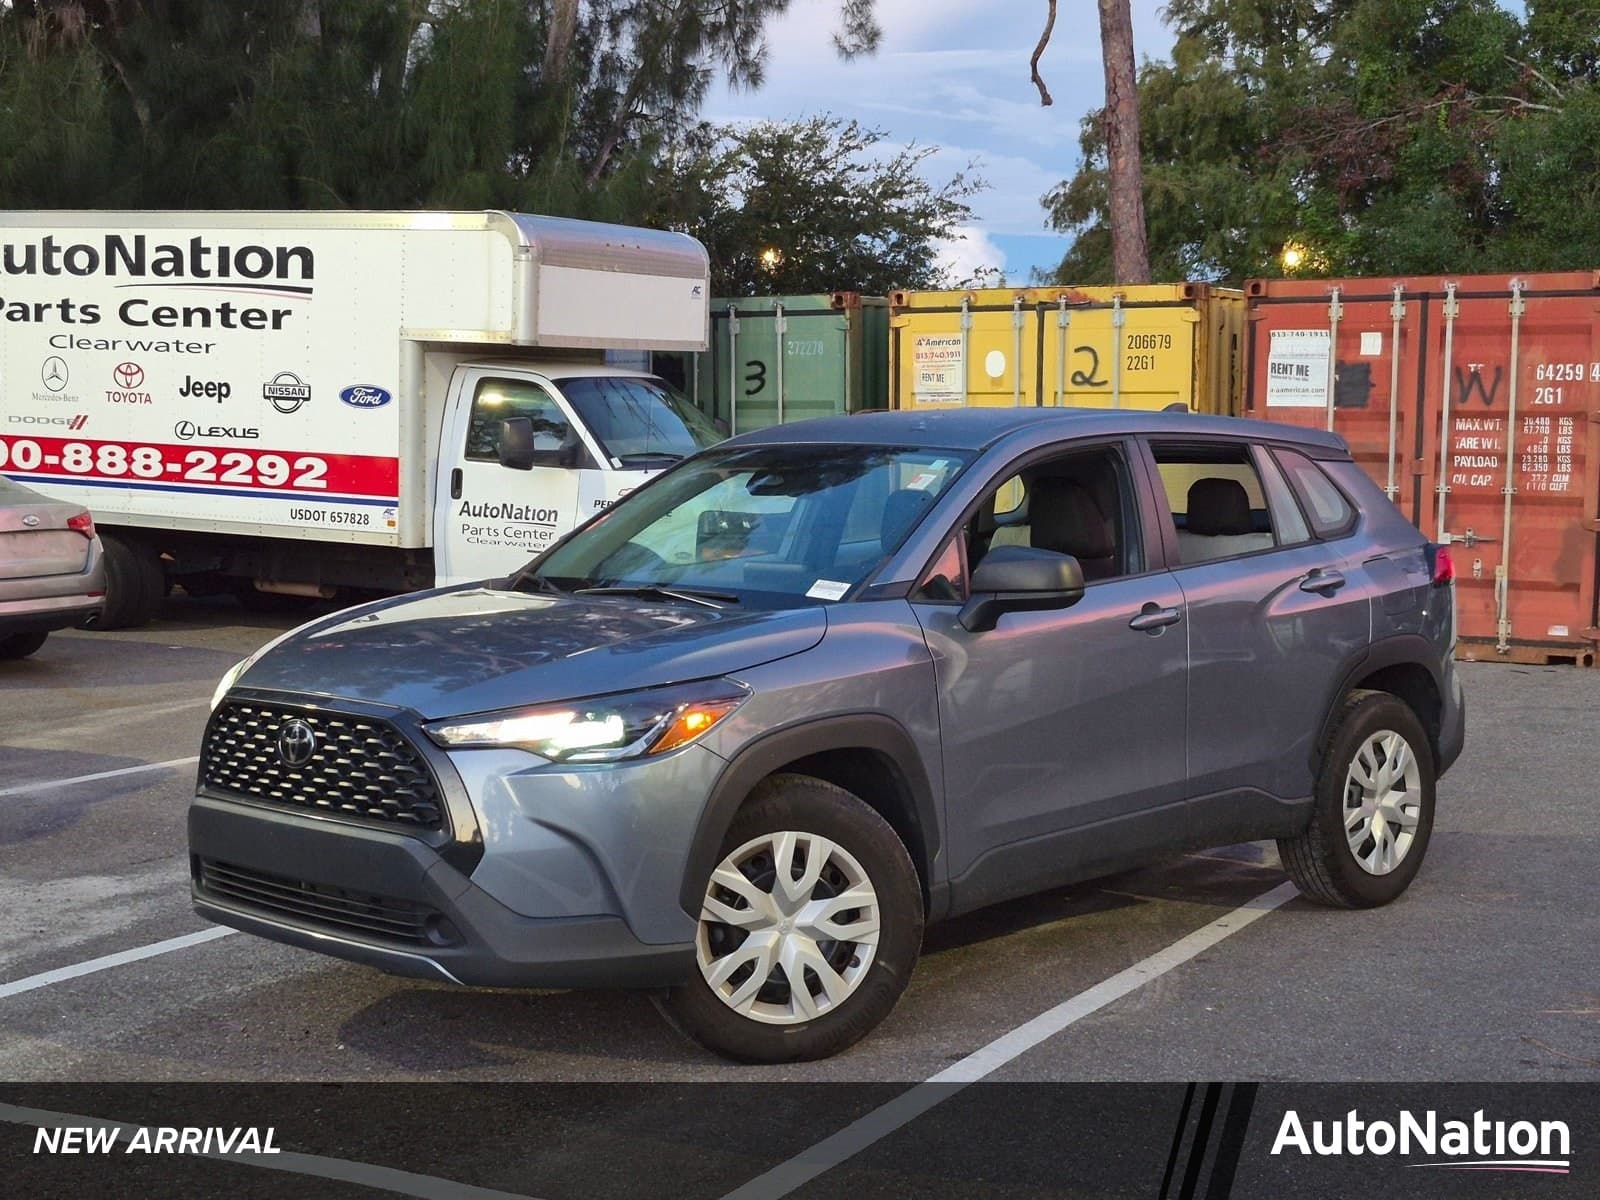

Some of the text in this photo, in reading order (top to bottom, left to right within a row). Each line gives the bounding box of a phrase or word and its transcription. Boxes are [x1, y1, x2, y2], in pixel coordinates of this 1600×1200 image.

[0, 234, 314, 279] utoNation
[118, 298, 292, 330] Center
[49, 334, 216, 354] Clearwater
[1127, 334, 1171, 349] 206679
[1070, 345, 1108, 387] 2
[1127, 355, 1154, 370] 22G1
[1271, 362, 1309, 377] RENT ME
[745, 360, 766, 395] 3
[179, 375, 231, 403] Jeep
[268, 386, 306, 396] NISSAN
[350, 387, 383, 406] Ford
[32, 393, 79, 402] Mercedes-Benz
[105, 391, 152, 404] TOYOTA
[8, 415, 76, 426] DODGE
[197, 426, 260, 439] LEXUS
[1558, 426, 1573, 435] LBS
[1556, 445, 1572, 454] LBS
[1453, 455, 1498, 468] PAYLOAD
[1557, 464, 1572, 473] LBS
[290, 508, 371, 526] USDOT 657828
[458, 501, 559, 523] AutoNation
[461, 523, 555, 540] Parts Center
[466, 537, 548, 549] Clearwater
